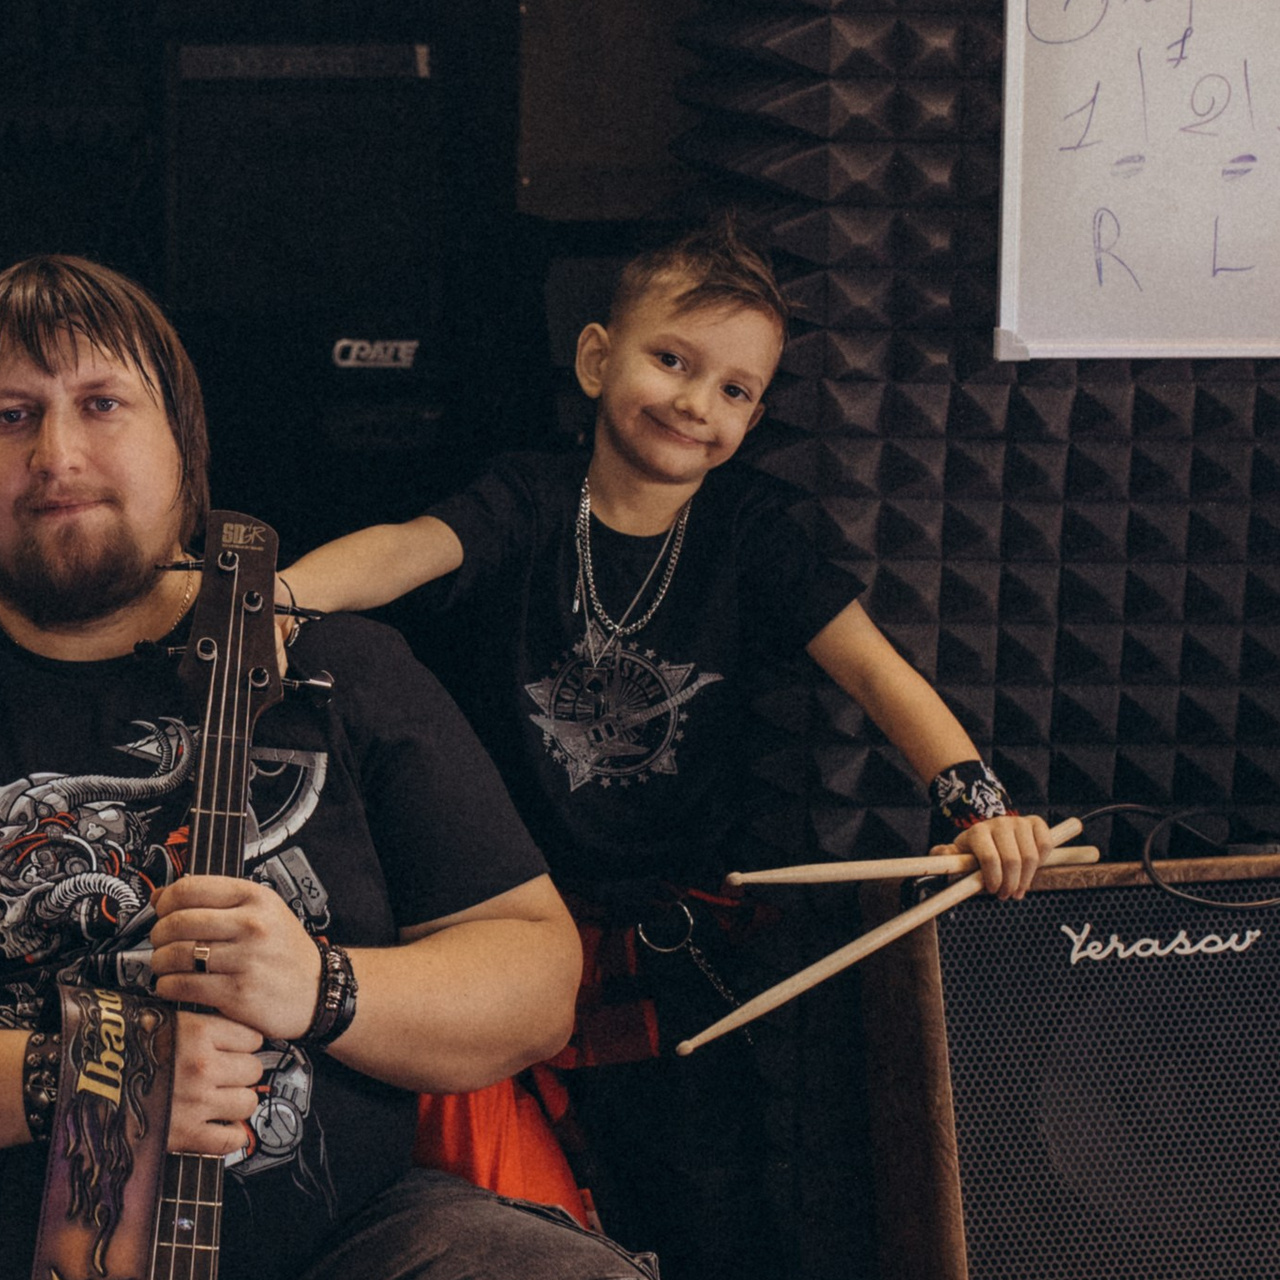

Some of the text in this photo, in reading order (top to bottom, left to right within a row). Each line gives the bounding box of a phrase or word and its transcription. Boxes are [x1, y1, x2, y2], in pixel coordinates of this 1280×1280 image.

[1092, 206, 1143, 292] R
[333, 338, 419, 368] CRATE
[1060, 922, 1262, 965] Yerasov
